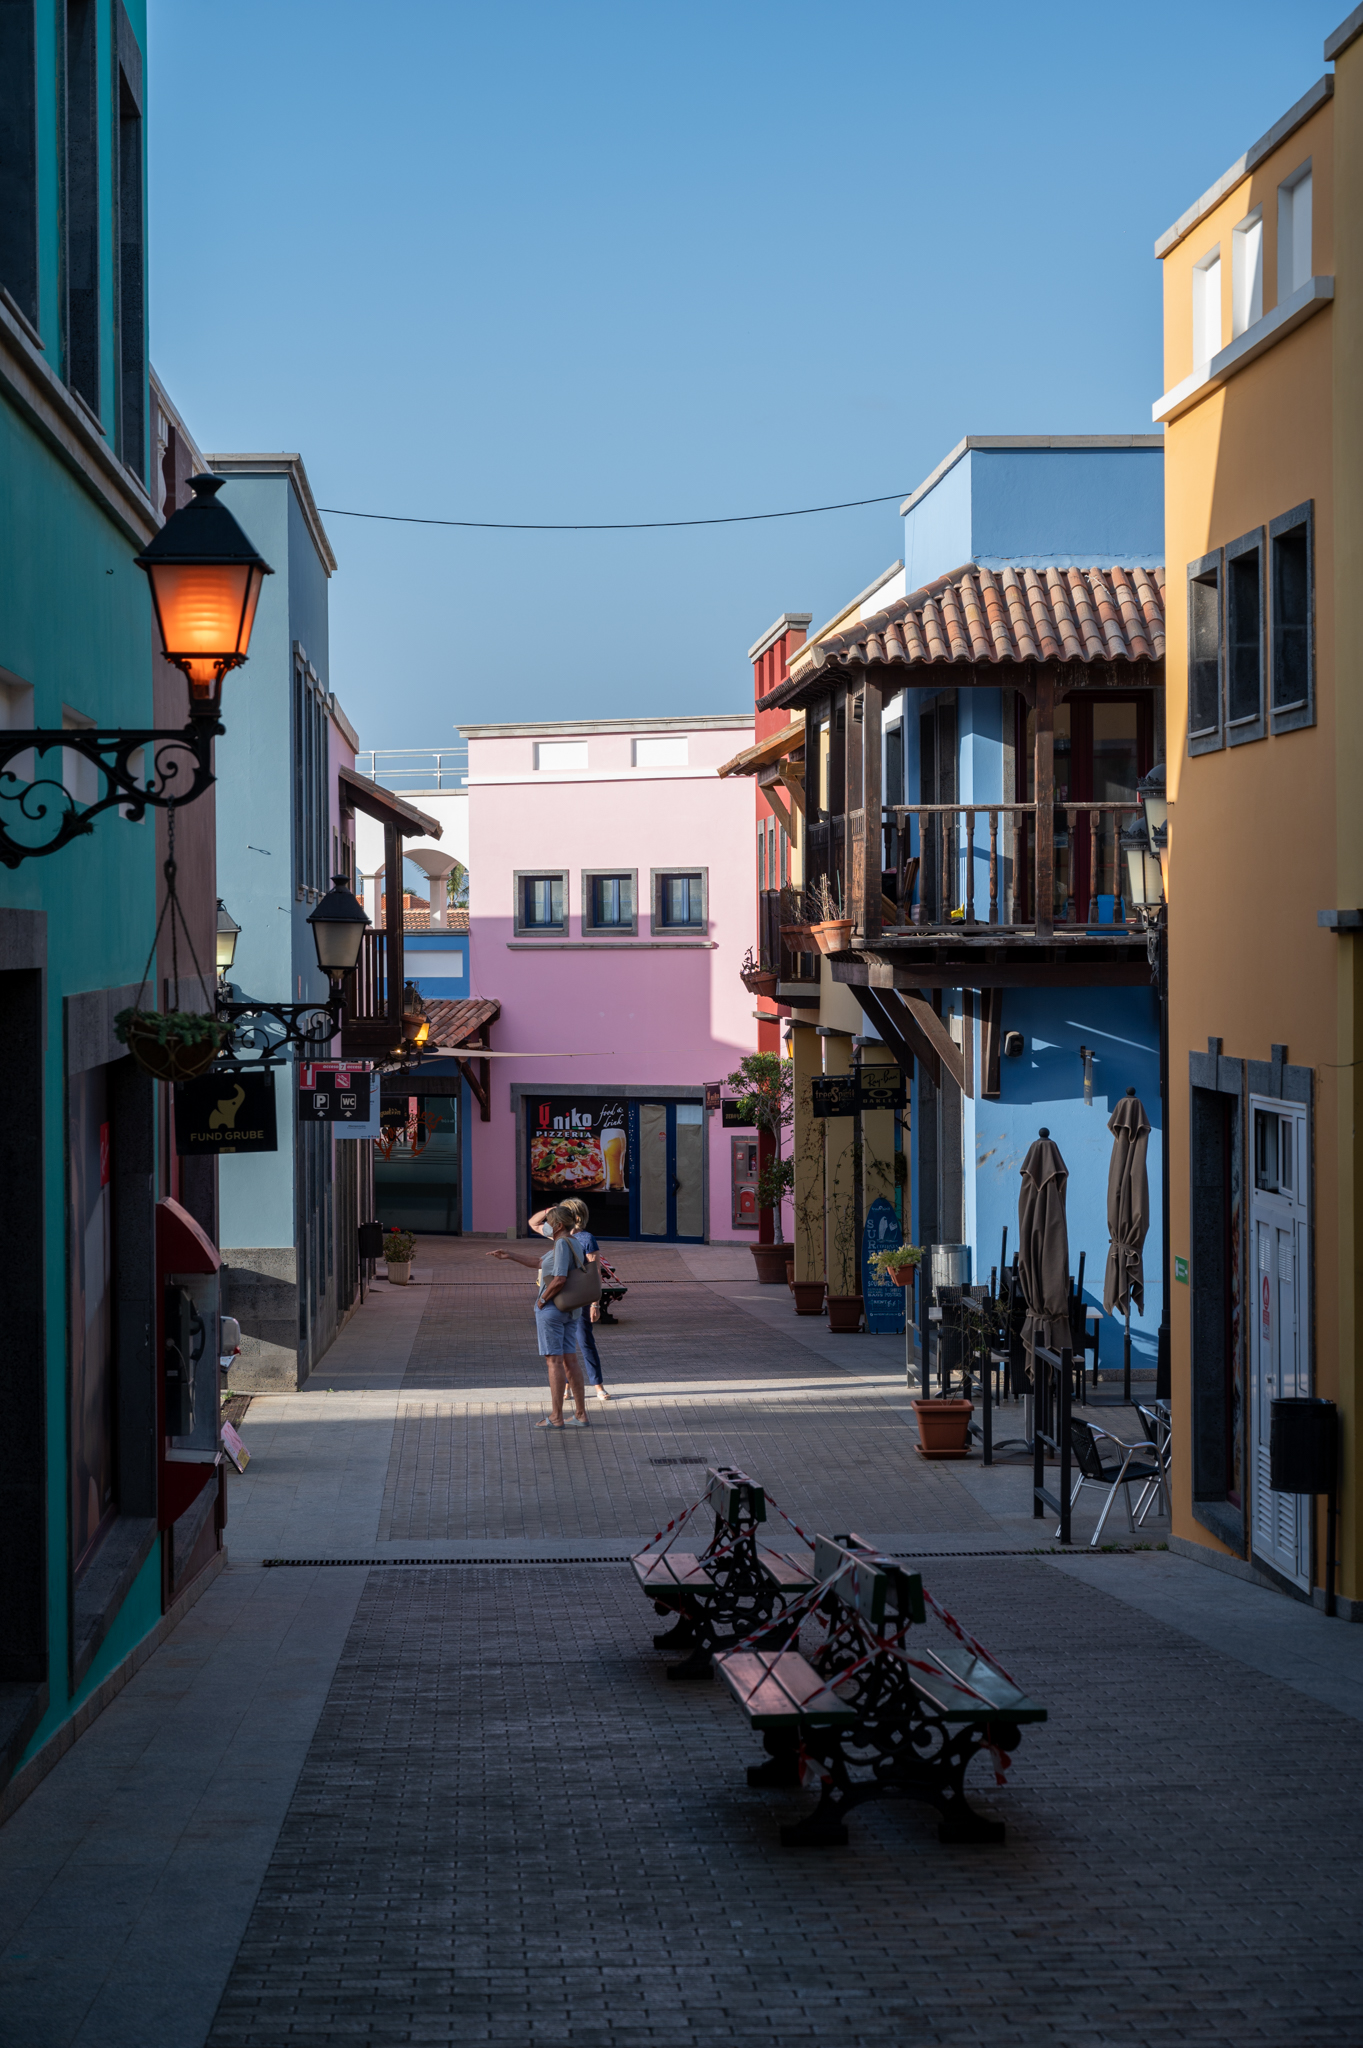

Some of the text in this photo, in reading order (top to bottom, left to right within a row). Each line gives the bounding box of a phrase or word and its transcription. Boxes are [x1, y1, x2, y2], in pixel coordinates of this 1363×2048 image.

[863, 1069, 898, 1087] Ray-Ban
[316, 1095, 326, 1108] P
[342, 1098, 355, 1106] WC
[593, 1103, 617, 1127] food
[603, 1114, 624, 1128] drink
[190, 1130, 264, 1142] FUND GRUBE
